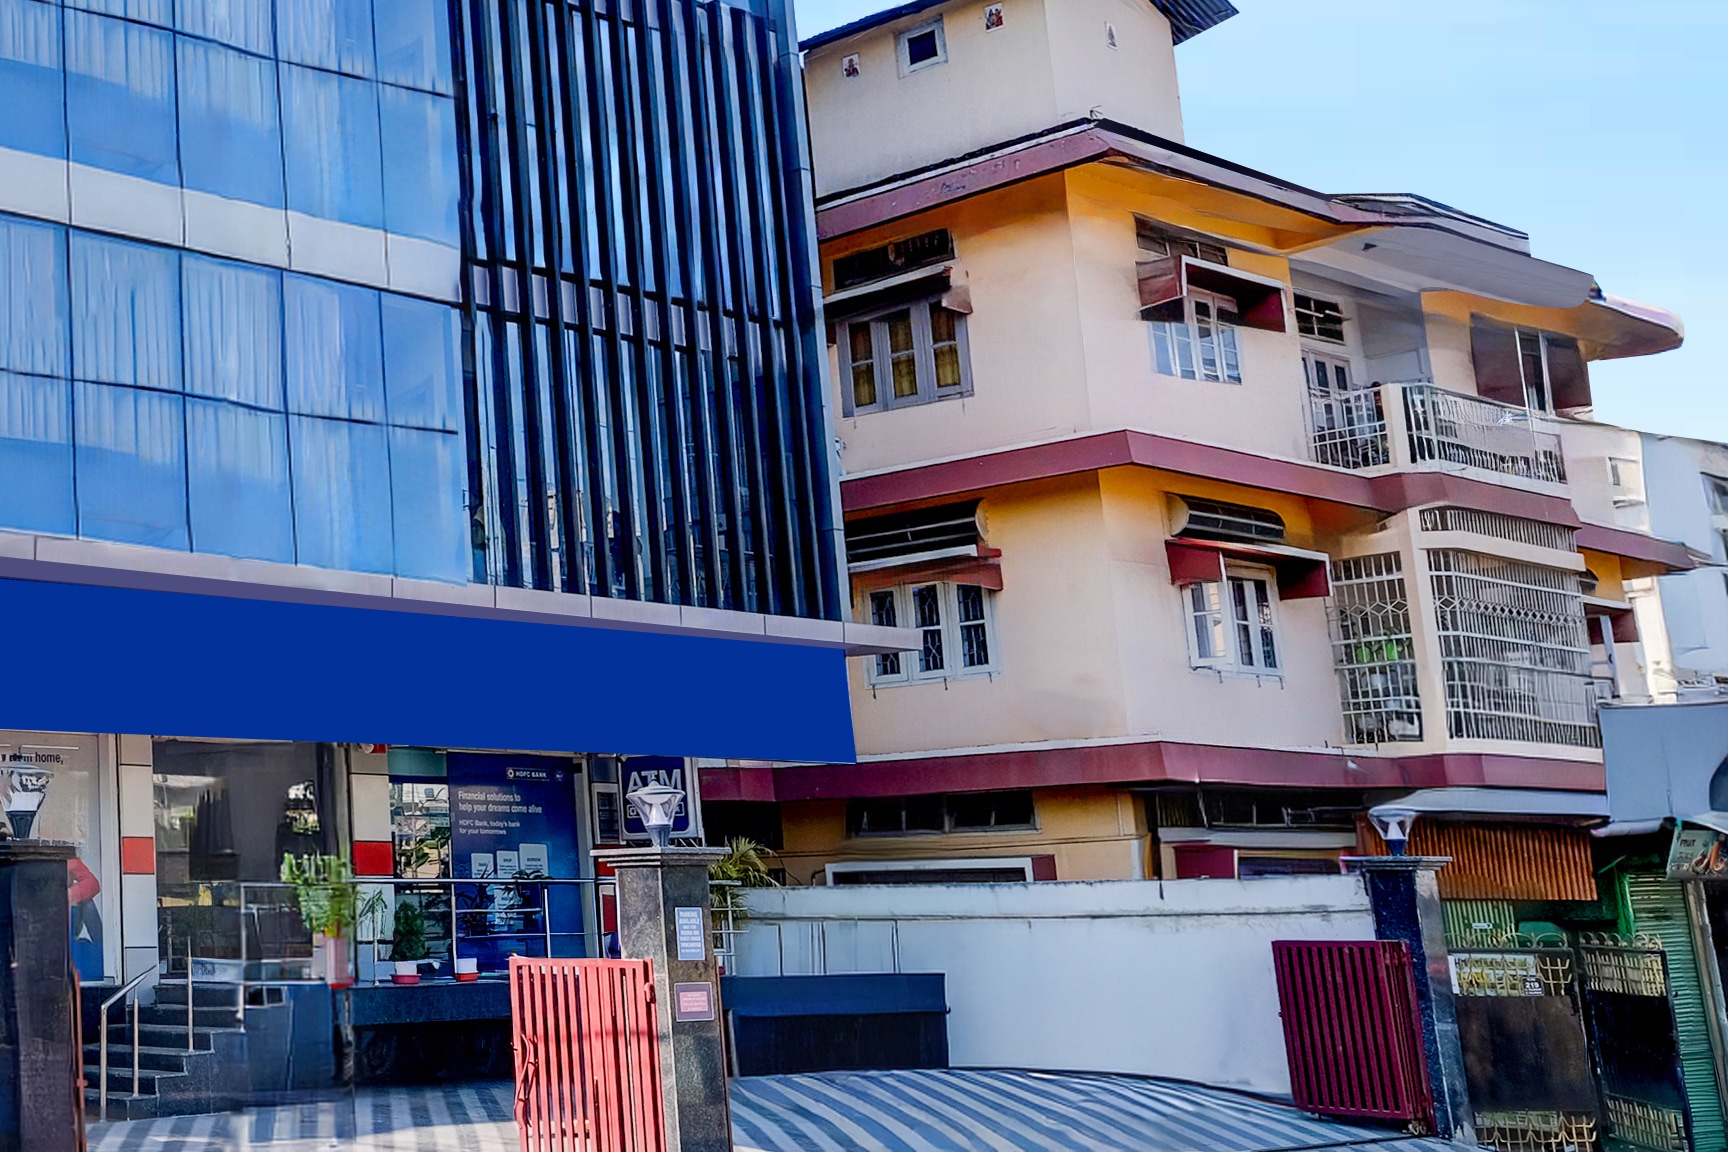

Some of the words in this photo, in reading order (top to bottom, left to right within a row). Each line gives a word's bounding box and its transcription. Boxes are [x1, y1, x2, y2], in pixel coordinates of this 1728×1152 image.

[35, 752, 63, 764] home,
[627, 769, 682, 793] ATM
[458, 791, 485, 800] Financial
[487, 793, 513, 801] solutions
[458, 802, 472, 812] help
[473, 804, 487, 813] your
[488, 803, 510, 812] dreams
